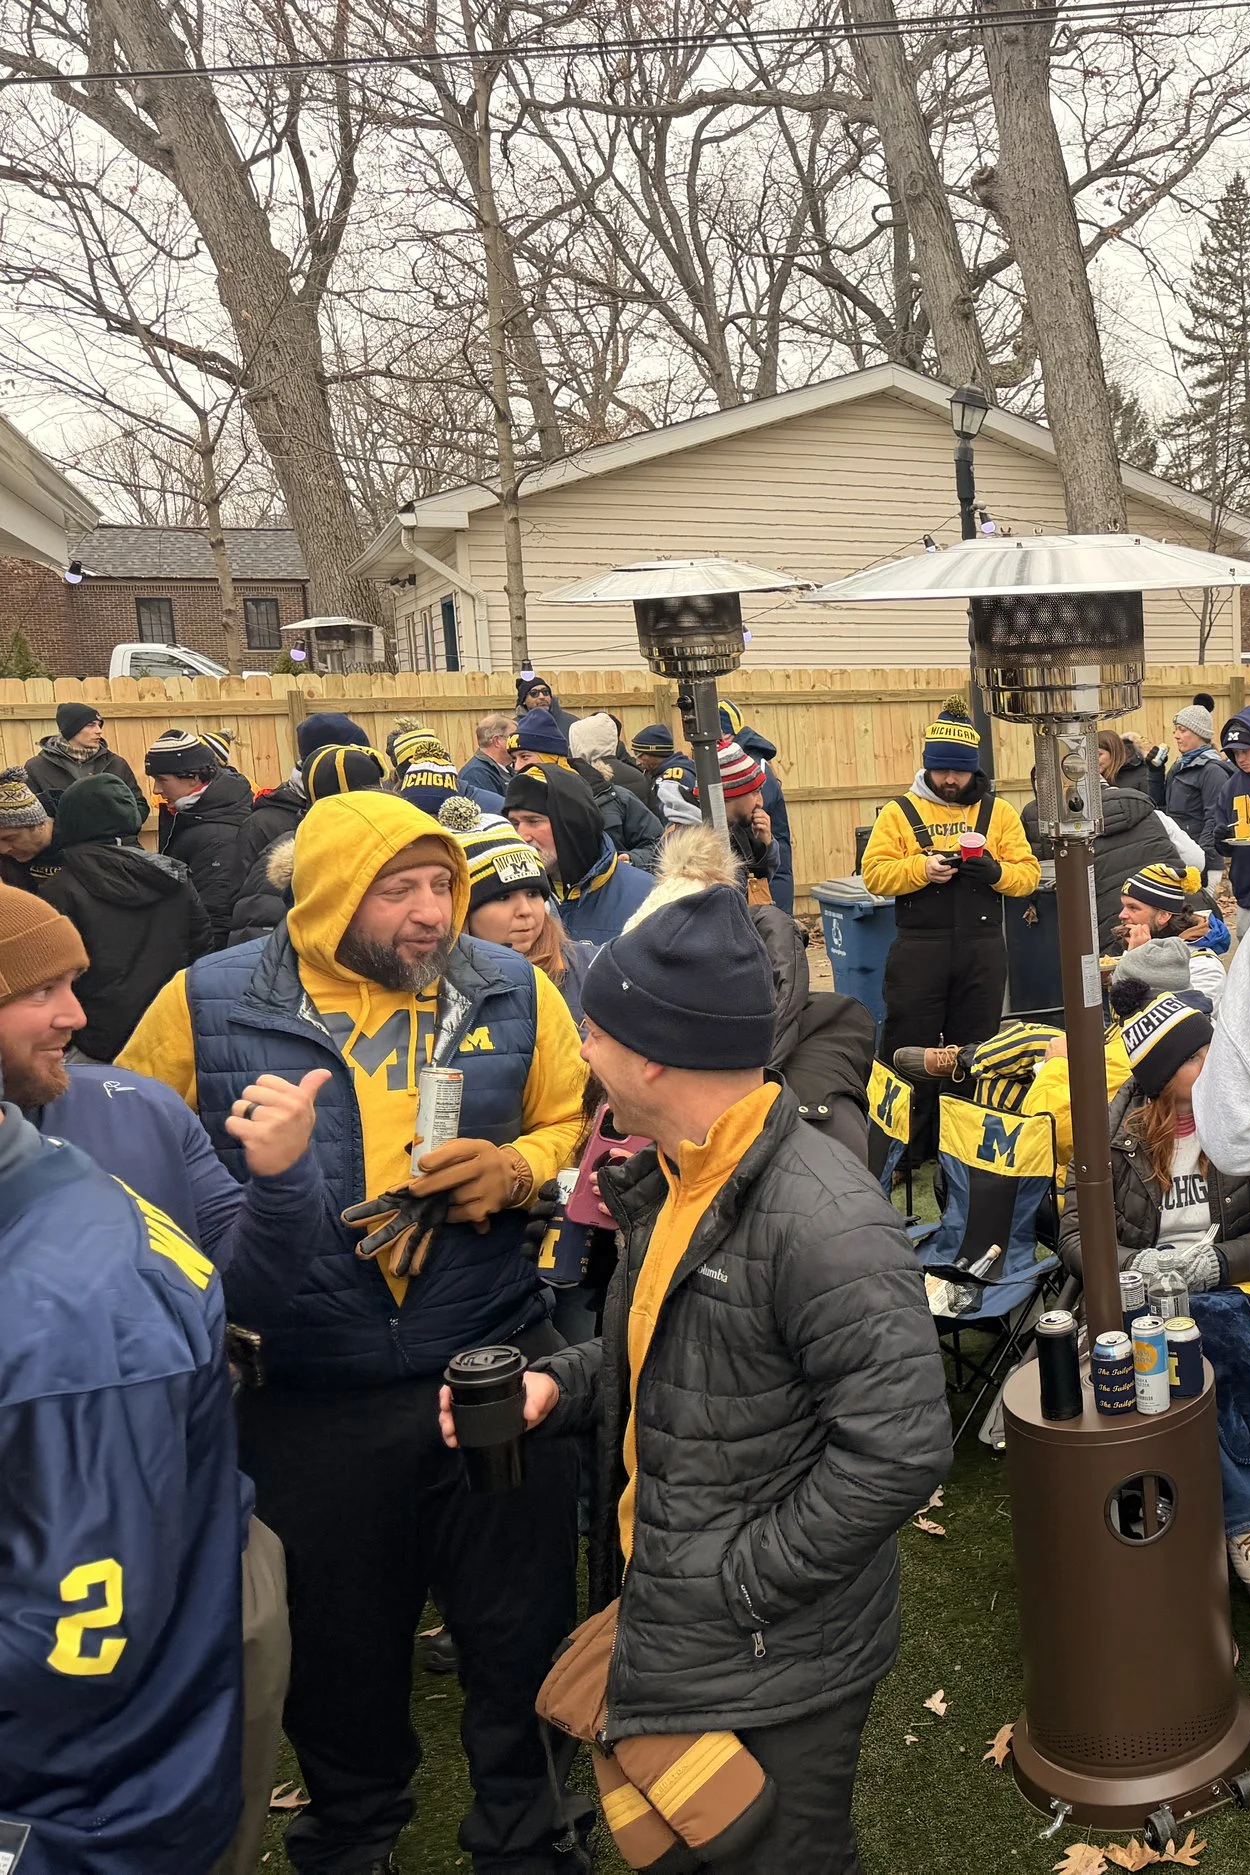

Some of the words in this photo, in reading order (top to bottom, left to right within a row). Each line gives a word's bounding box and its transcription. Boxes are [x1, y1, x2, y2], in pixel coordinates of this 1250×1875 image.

[930, 725, 976, 741] MICHIGAN
[1228, 731, 1240, 741] M
[494, 851, 537, 873] MICHIGAN
[509, 860, 530, 875] M
[459, 1026, 495, 1052] M
[976, 1113, 1025, 1168] M
[697, 1263, 729, 1283] olumbia
[47, 1558, 128, 1676] 2
